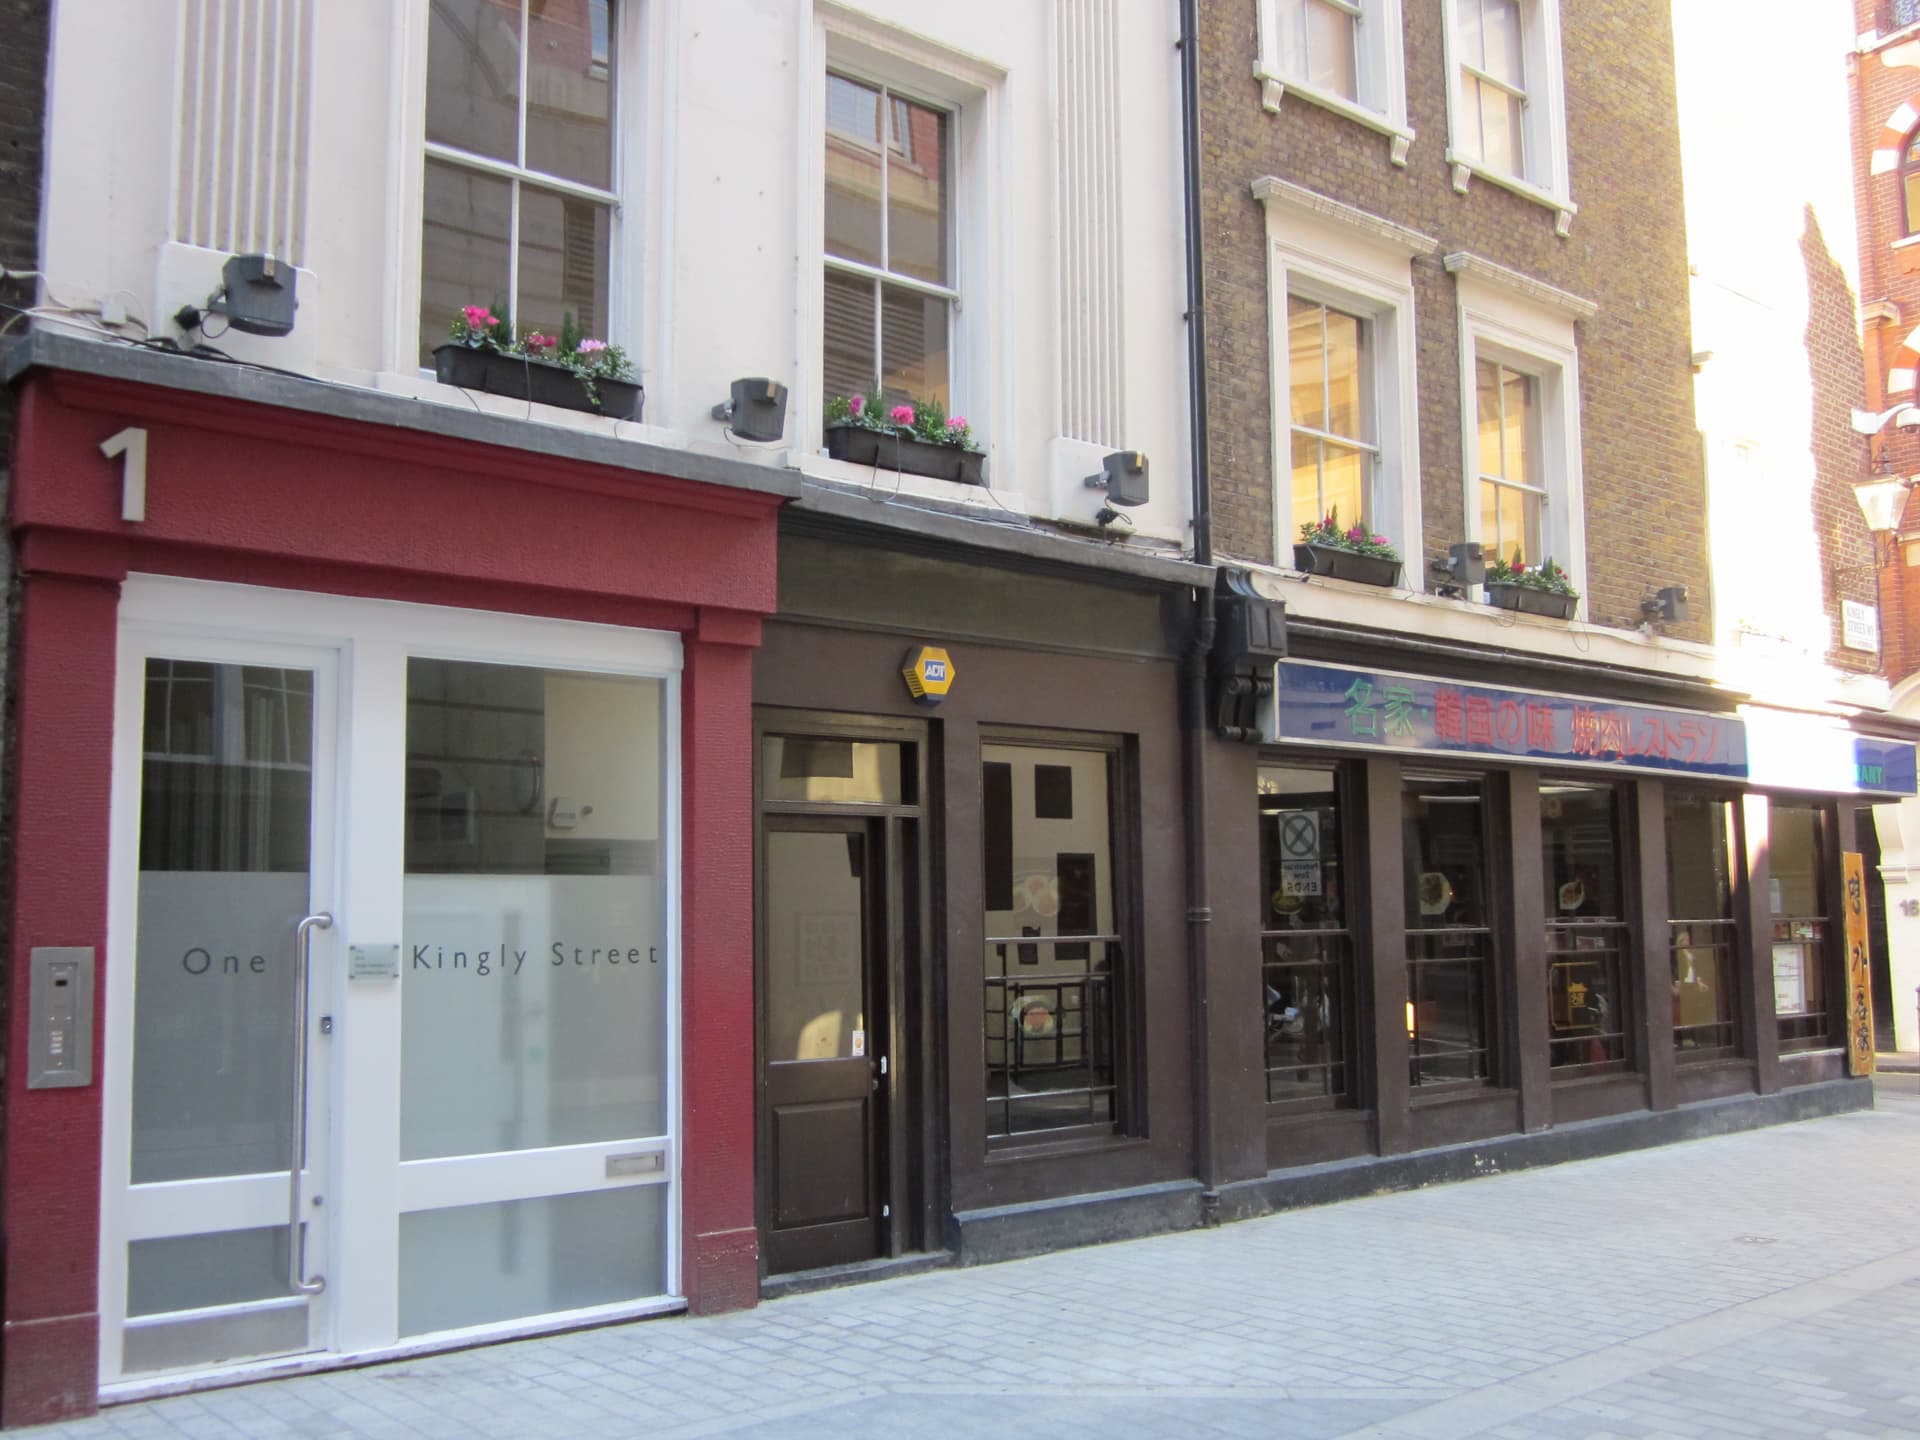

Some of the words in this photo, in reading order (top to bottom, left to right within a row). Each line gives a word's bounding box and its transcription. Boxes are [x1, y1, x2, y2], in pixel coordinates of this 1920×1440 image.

[99, 426, 148, 521] 1
[925, 664, 945, 678] ADT
[183, 947, 265, 975] One
[413, 943, 527, 976] Kingly
[551, 942, 659, 966] Street
